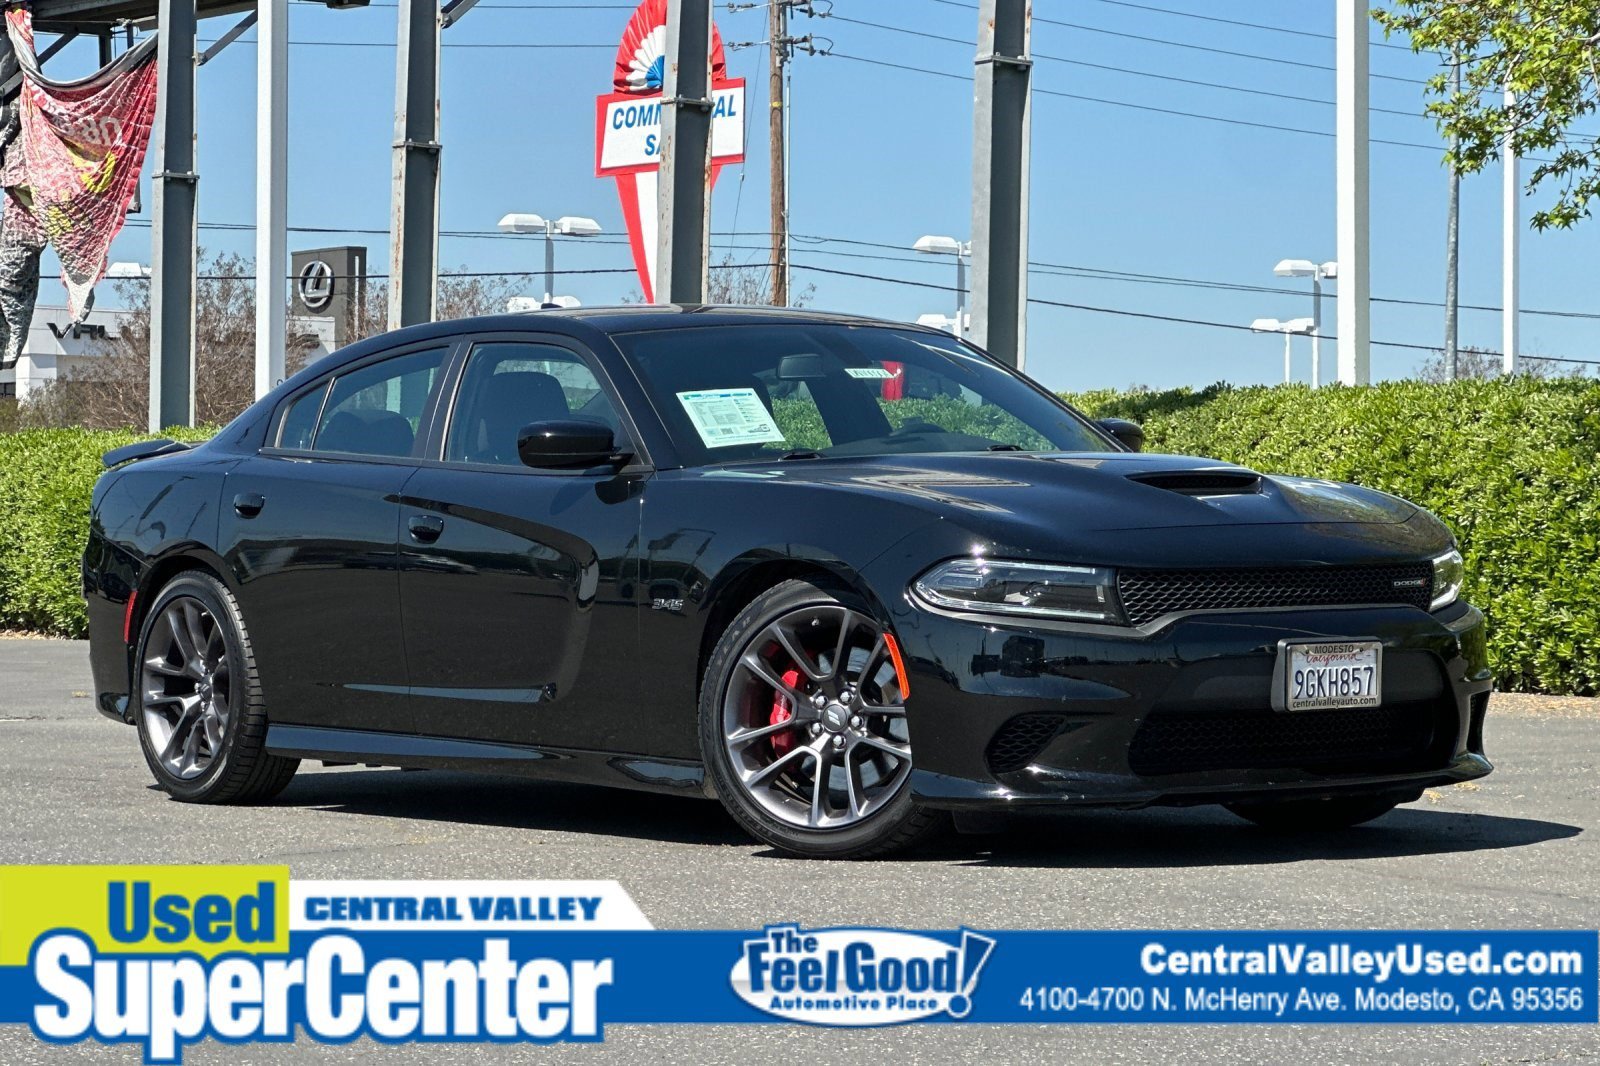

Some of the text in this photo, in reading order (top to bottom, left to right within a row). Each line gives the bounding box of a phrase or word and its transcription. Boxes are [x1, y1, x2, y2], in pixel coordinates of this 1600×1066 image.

[612, 94, 736, 130] COMMAL
[651, 598, 684, 611] 345
[1314, 645, 1354, 655] MODESTO
[1307, 653, 1362, 666] California
[1293, 667, 1374, 700] 9GKH857
[1292, 697, 1377, 710] centralvalleyauto.com
